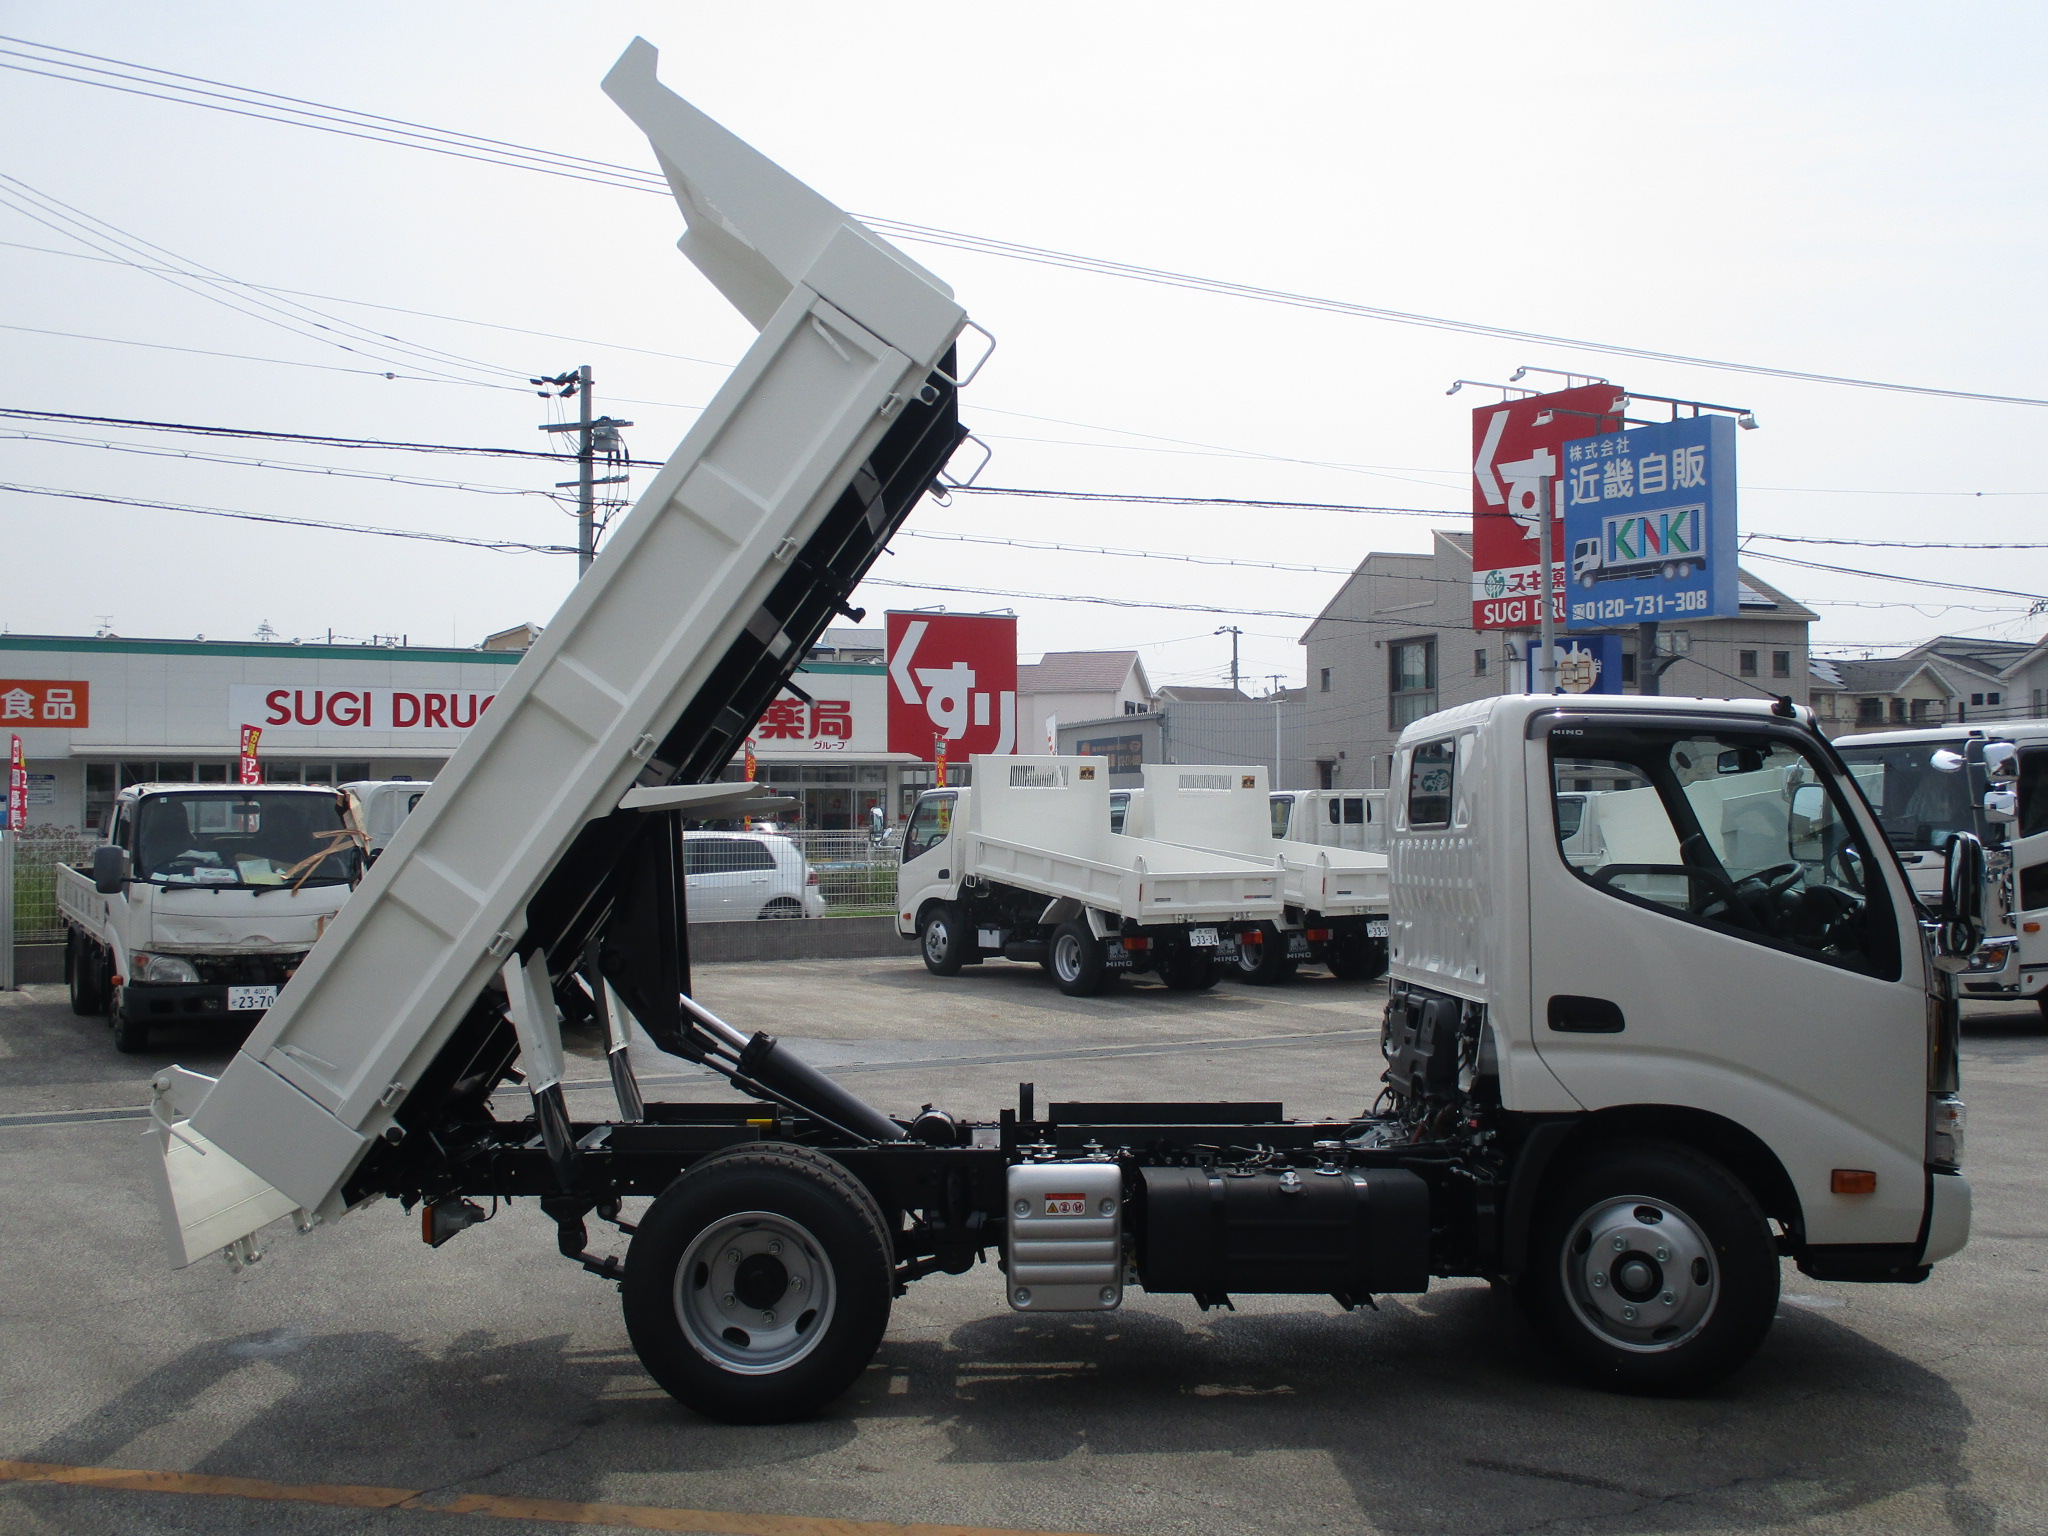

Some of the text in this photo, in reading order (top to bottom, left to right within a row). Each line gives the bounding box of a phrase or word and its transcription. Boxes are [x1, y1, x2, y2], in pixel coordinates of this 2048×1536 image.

[1569, 436, 1630, 463] 株式会社
[1474, 409, 1565, 541] くす
[1570, 445, 1706, 506] 近畿自販
[1608, 510, 1700, 562] KNKI
[1484, 600, 1526, 624] SUGI
[1585, 590, 1707, 620] 0120-731-308
[889, 620, 1016, 755] くすり
[1, 688, 76, 719] 食品
[266, 690, 496, 728] SUGI DRU
[759, 698, 852, 740] 薬局
[814, 740, 848, 750] グループ
[1106, 960, 1133, 968] HINO
[1213, 955, 1239, 963] HINO
[1286, 951, 1312, 959] HINO
[239, 995, 275, 1009] 23-70
